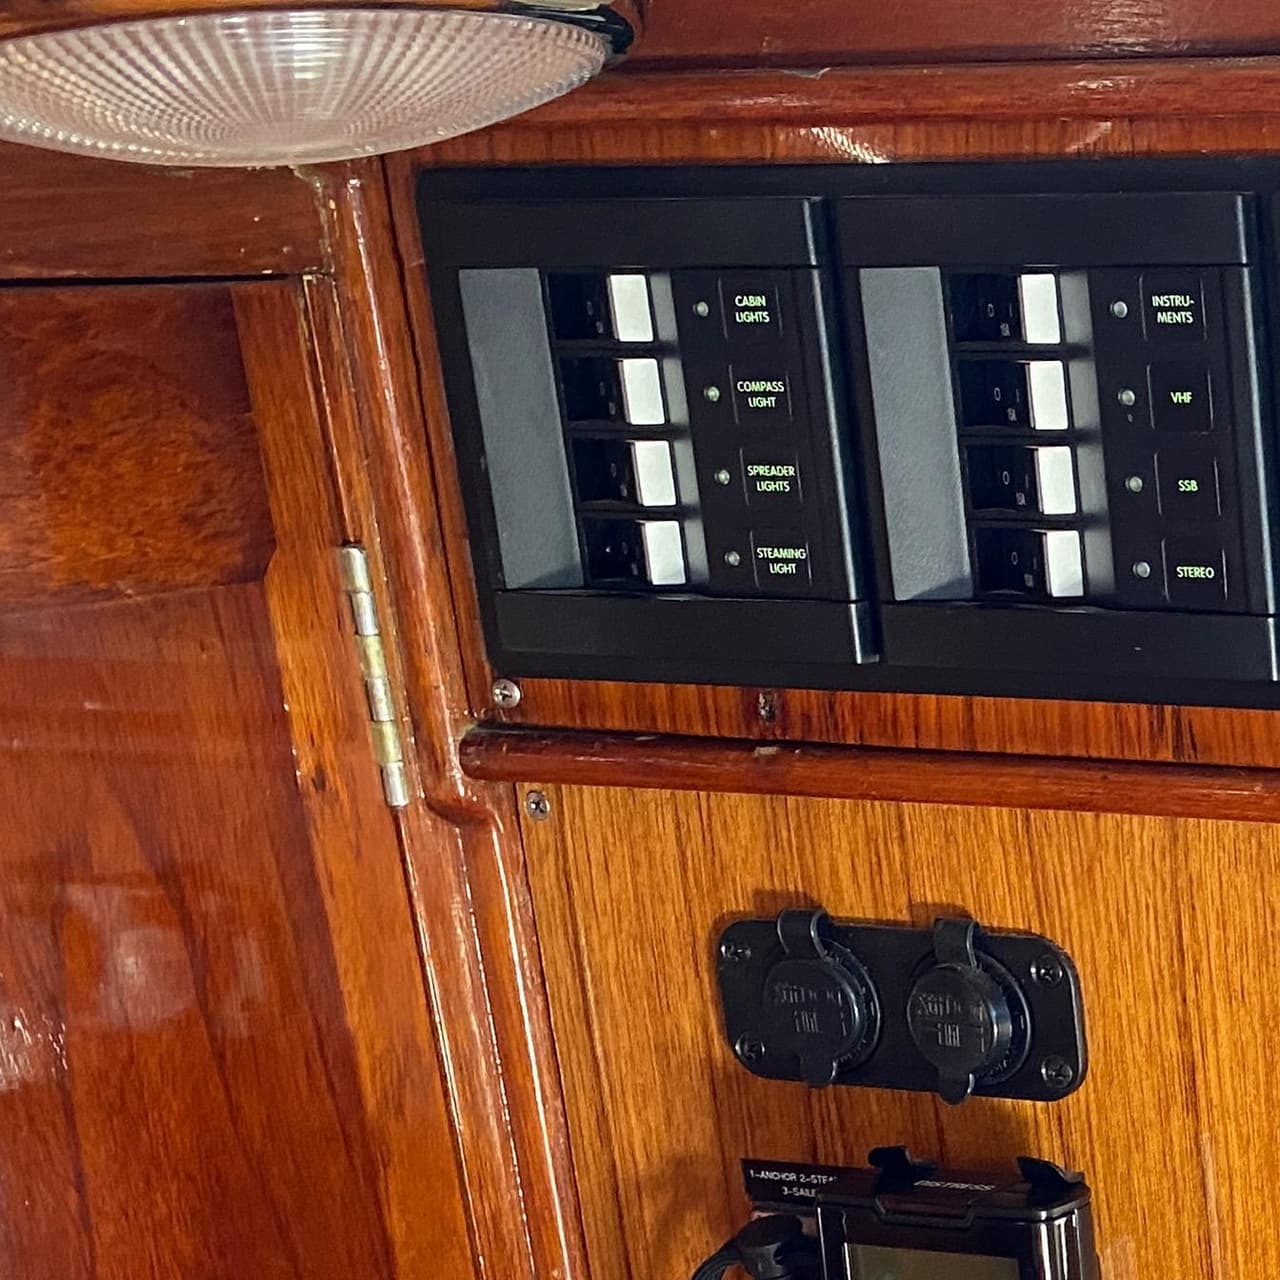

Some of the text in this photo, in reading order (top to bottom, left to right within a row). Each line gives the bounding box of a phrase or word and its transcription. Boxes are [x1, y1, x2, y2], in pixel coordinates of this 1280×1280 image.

[735, 295, 766, 307] CABIN
[1151, 295, 1195, 307] INSTRU-
[735, 311, 770, 323] LIGHTS
[1157, 311, 1194, 324] MENTS
[737, 381, 785, 393] COMPASS
[748, 397, 777, 408] LIGHT
[1170, 391, 1193, 404] VHF
[747, 465, 795, 477] SPREADER
[756, 481, 790, 492] LIGHTS
[1178, 479, 1199, 492] SSB
[757, 547, 806, 559] STEAMING
[769, 563, 797, 574] LIGHT
[1176, 566, 1215, 579] STEREO
[799, 1174, 837, 1185] 2-STE
